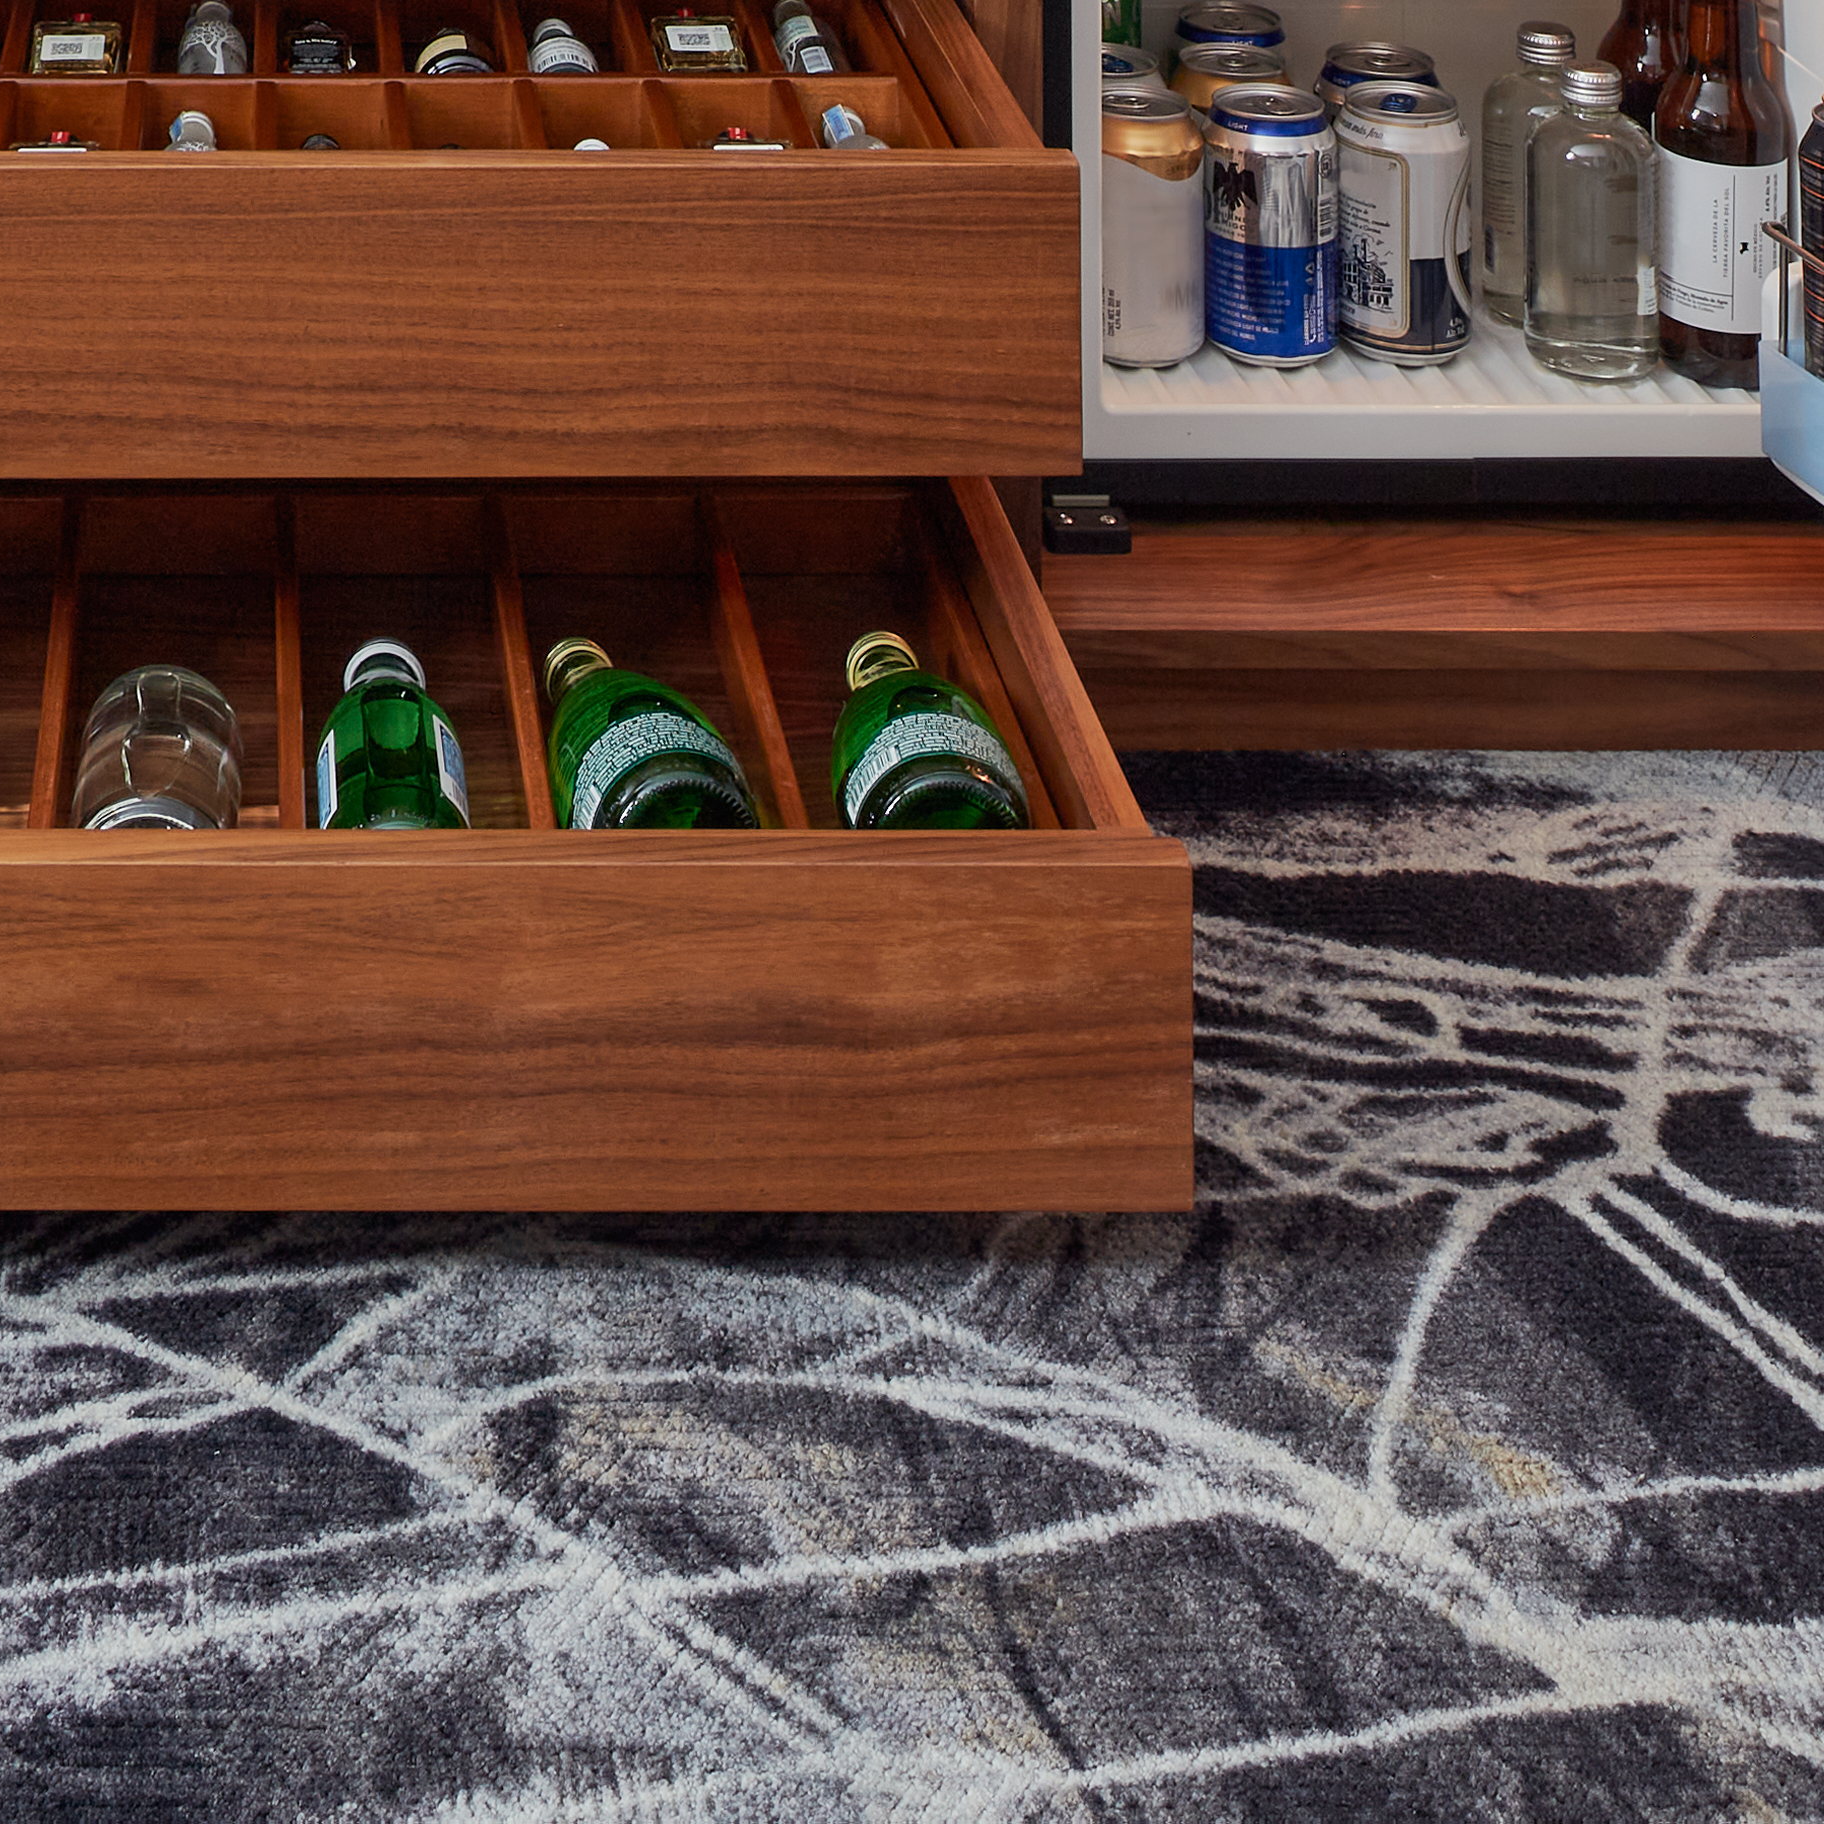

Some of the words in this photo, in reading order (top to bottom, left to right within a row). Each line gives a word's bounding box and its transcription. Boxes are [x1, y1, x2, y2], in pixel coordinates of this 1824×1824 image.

[1227, 121, 1248, 131] LIGHT
[1713, 198, 1719, 208] LA
[1712, 210, 1718, 220] DE
[1712, 254, 1718, 264] LA
